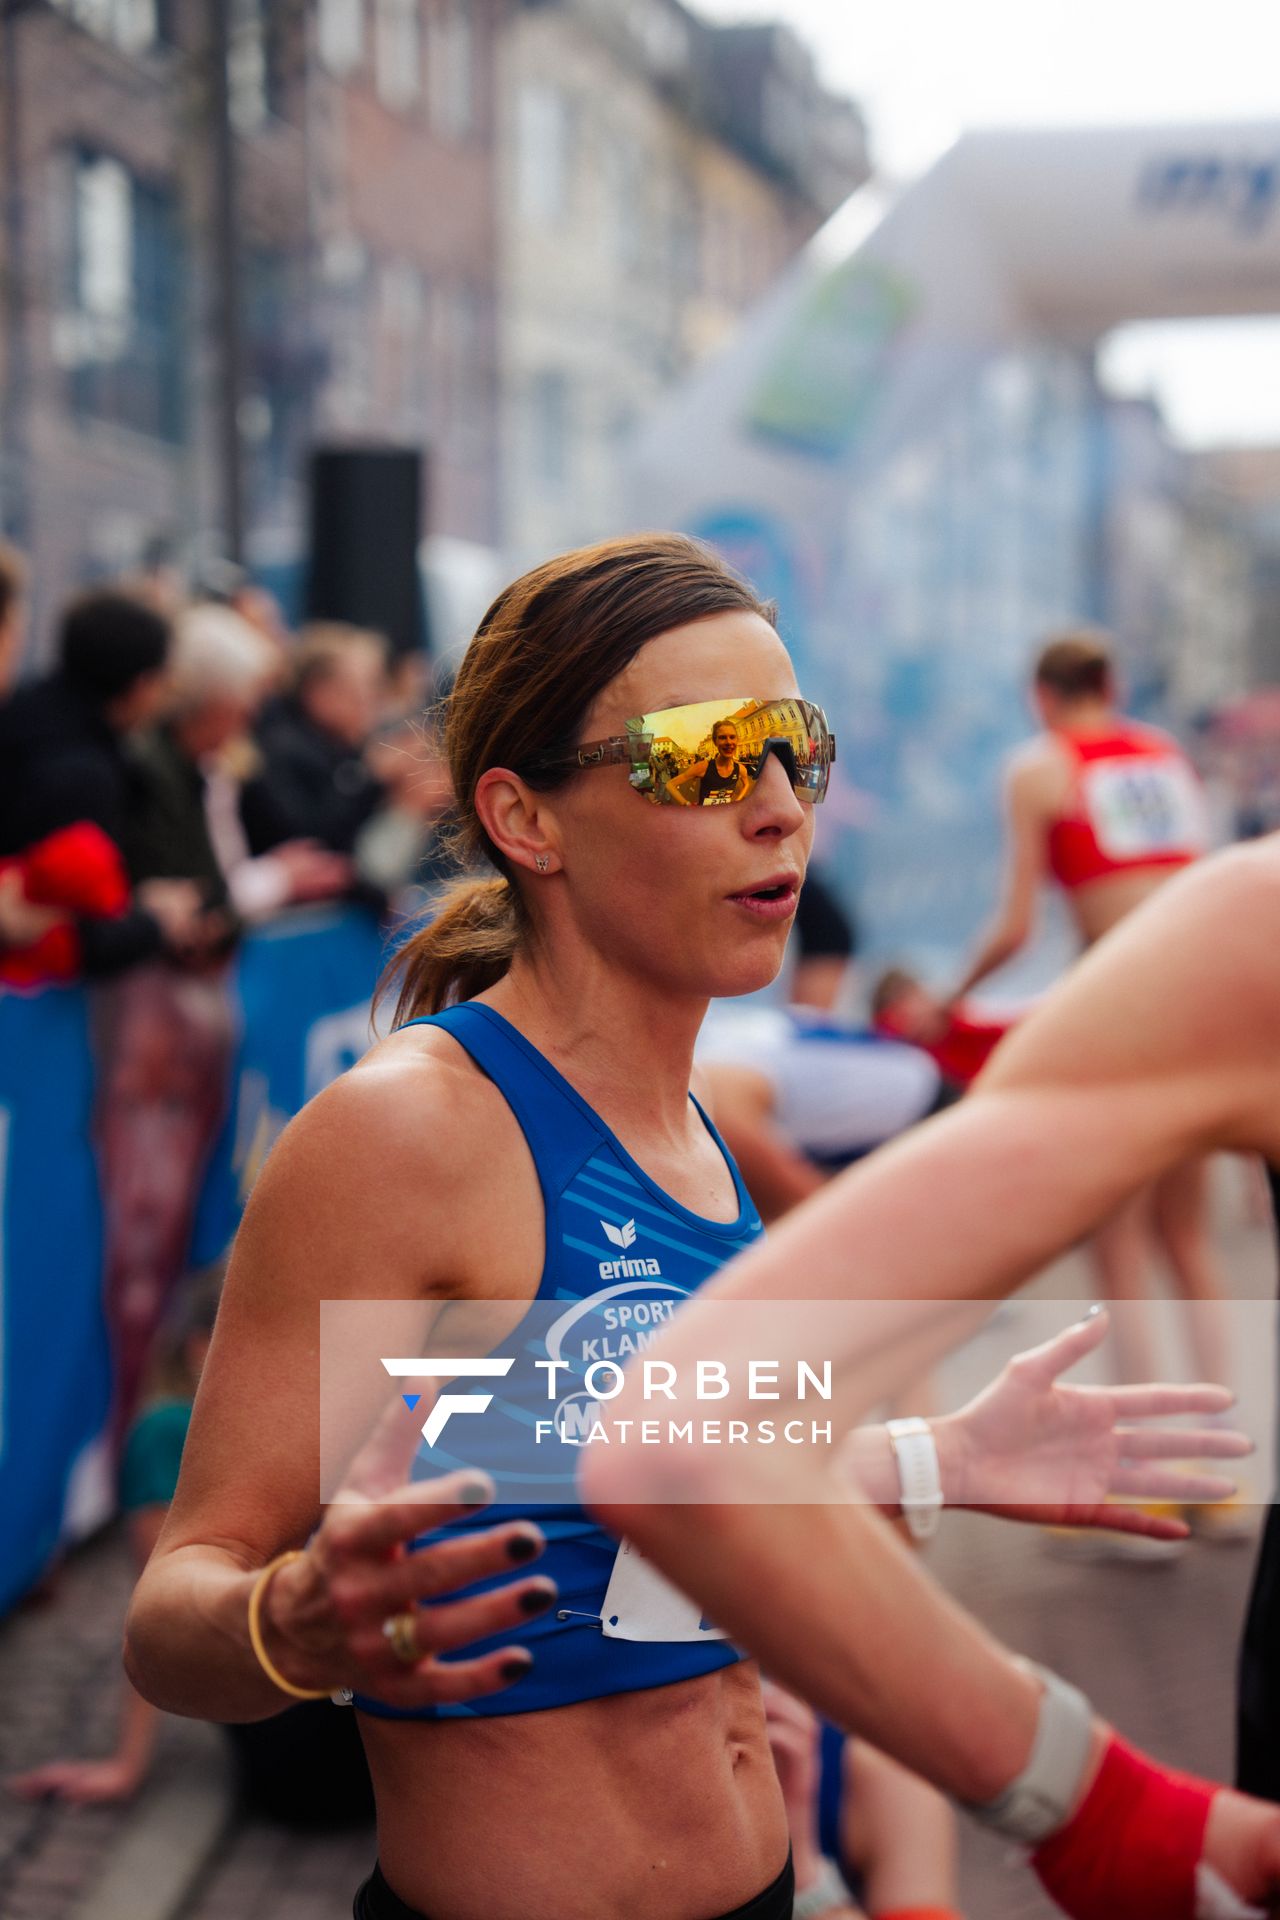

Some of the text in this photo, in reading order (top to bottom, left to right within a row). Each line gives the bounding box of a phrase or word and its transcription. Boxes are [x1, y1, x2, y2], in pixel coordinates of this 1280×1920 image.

[599, 1255, 661, 1280] erima
[603, 1300, 675, 1330] SPORT
[582, 1329, 666, 1361] KLAM
